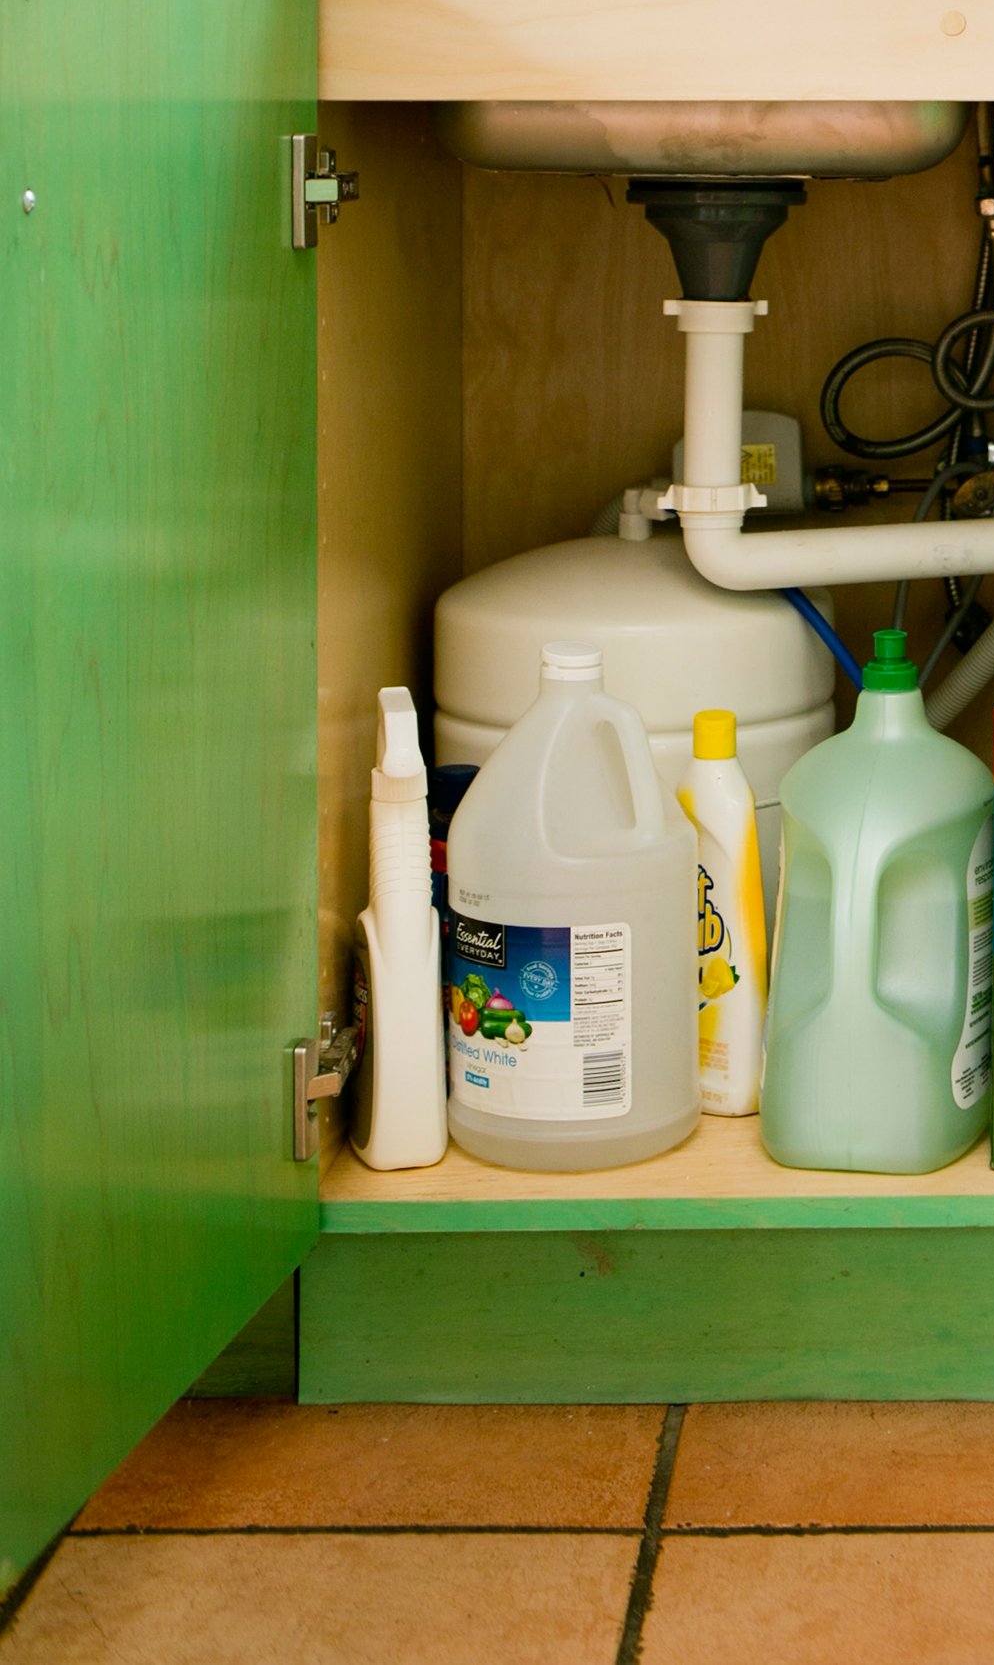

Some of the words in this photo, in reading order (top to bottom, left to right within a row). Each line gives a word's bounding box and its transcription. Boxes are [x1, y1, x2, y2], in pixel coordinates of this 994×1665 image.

[456, 922, 502, 950] Essential
[457, 941, 500, 960] EVERYDAY
[483, 1048, 517, 1067] White
